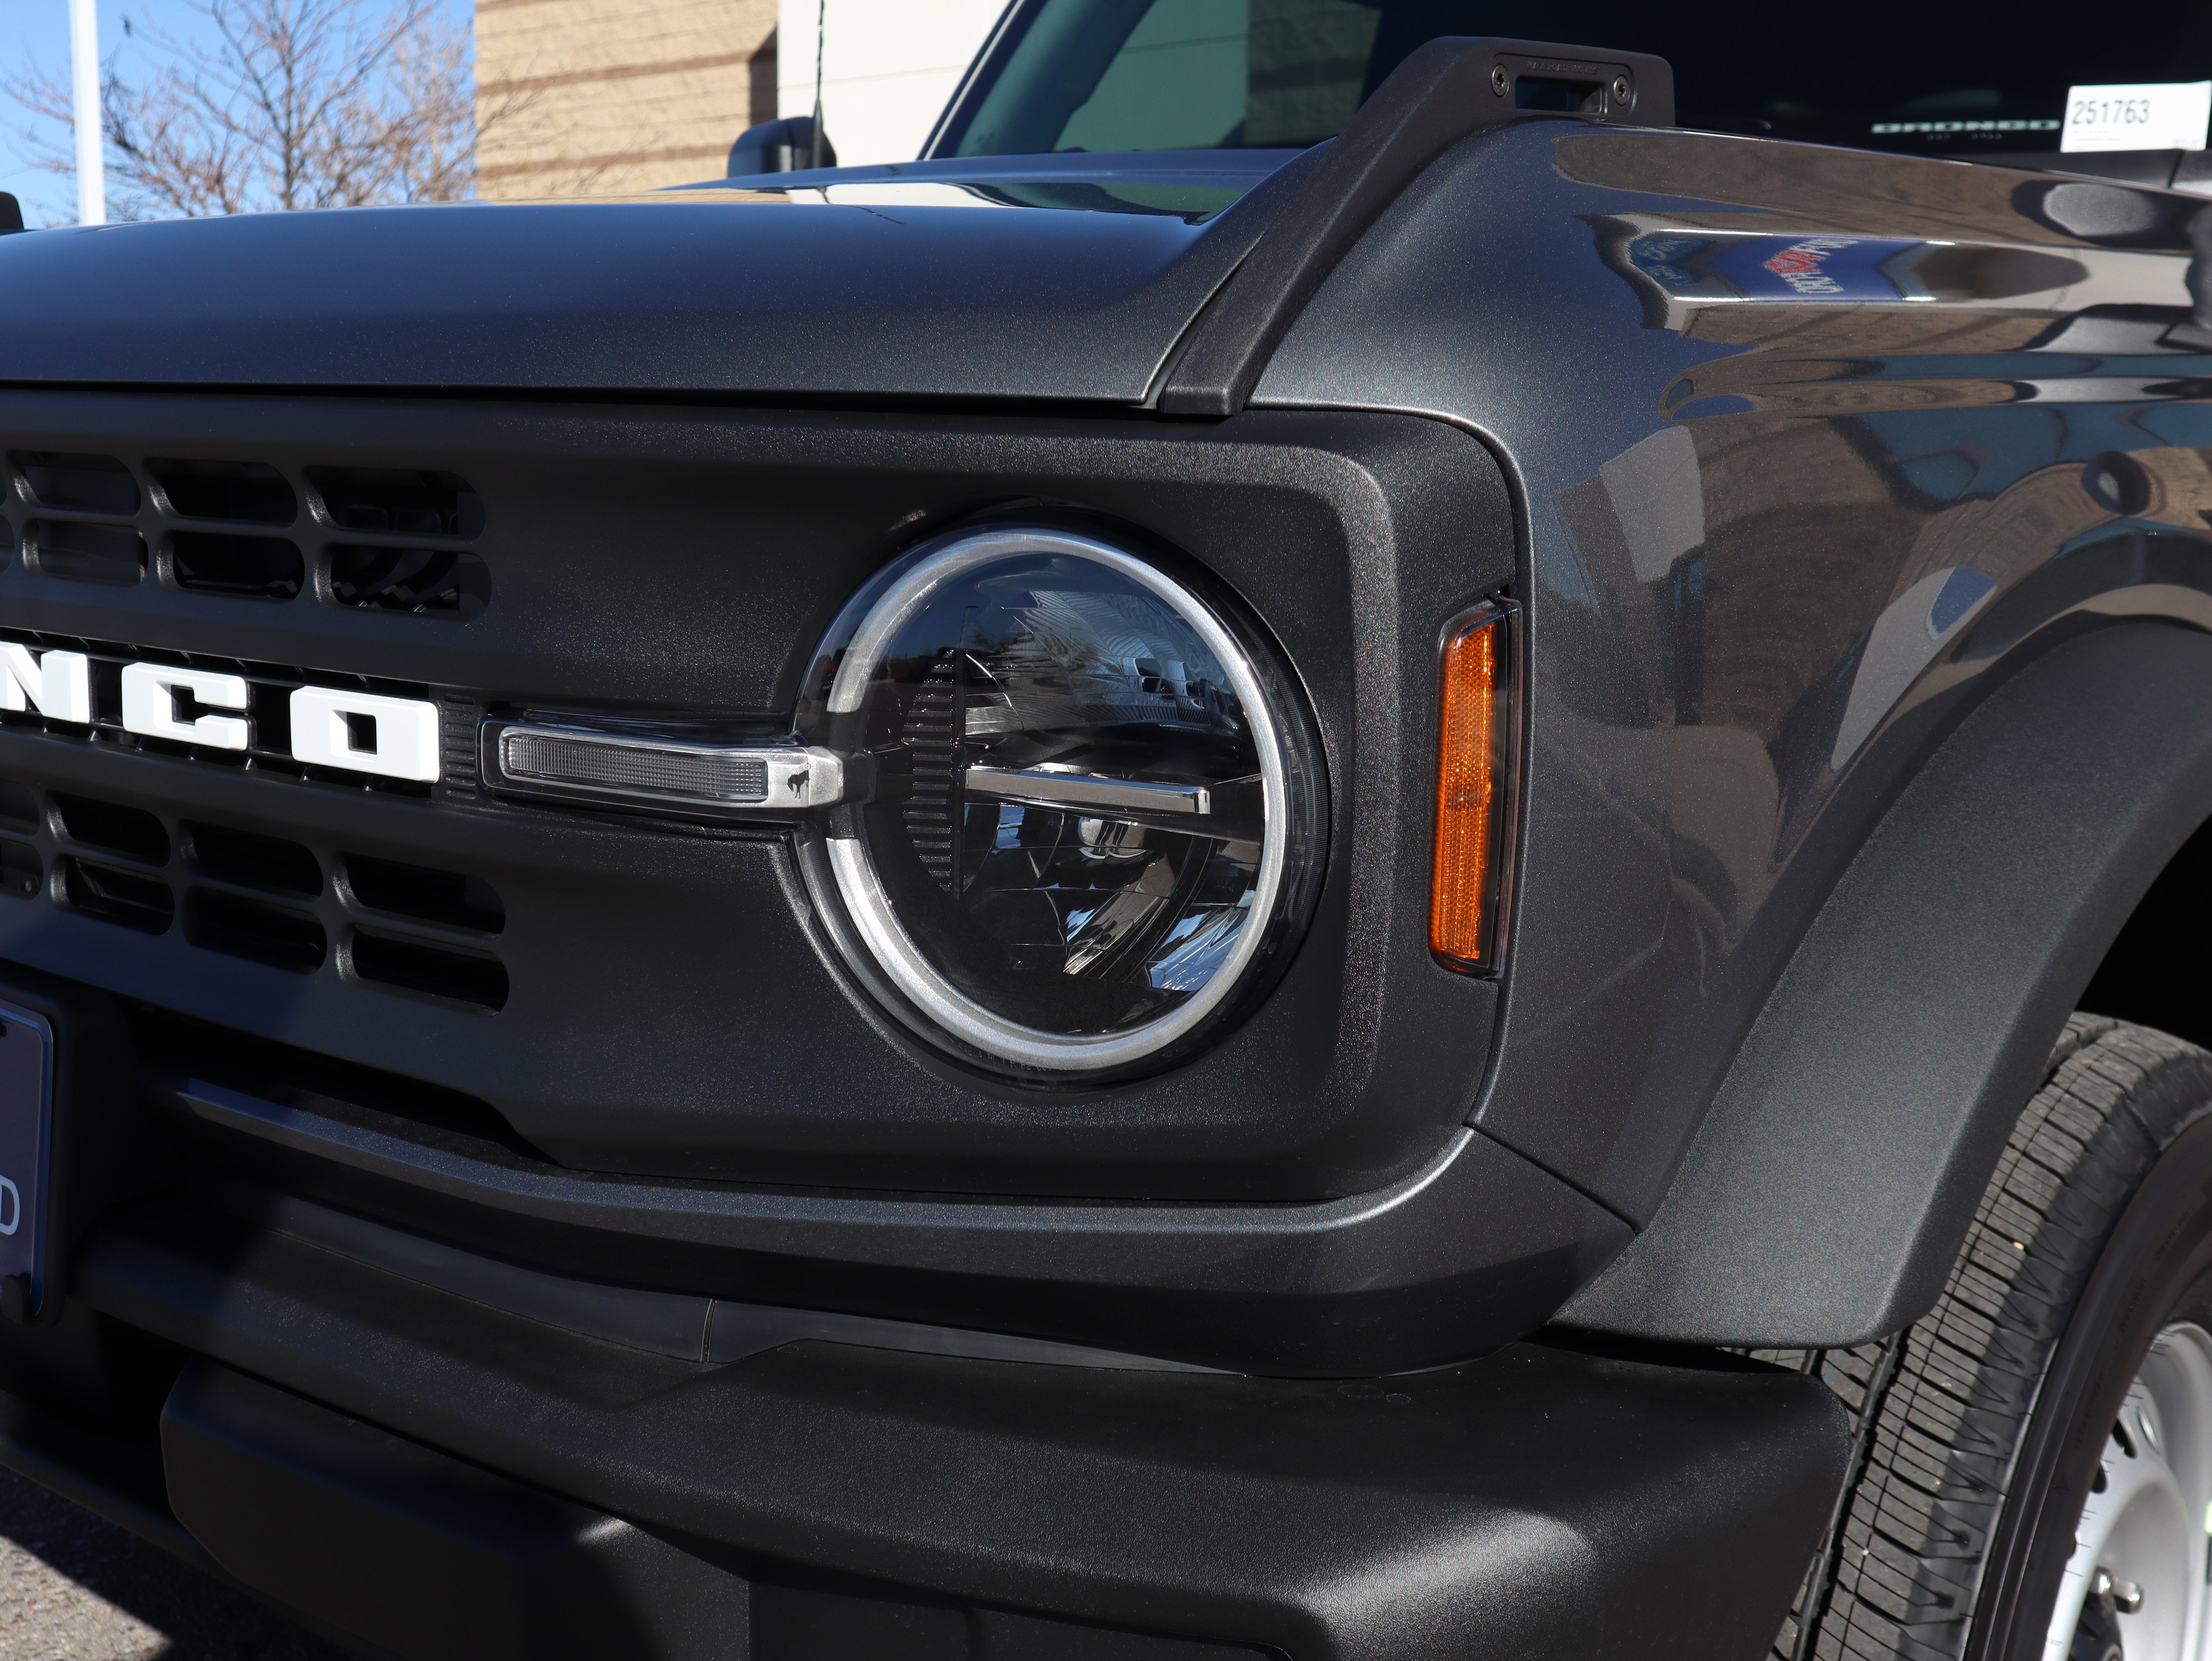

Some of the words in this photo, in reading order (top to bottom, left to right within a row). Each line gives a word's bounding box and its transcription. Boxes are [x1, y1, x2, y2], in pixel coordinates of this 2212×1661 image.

[1526, 61, 1545, 71] MAX
[1547, 63, 1568, 72] LOAD
[1585, 66, 1600, 75] LBS
[2072, 100, 2150, 125] 251763
[0, 641, 442, 784] NCO
